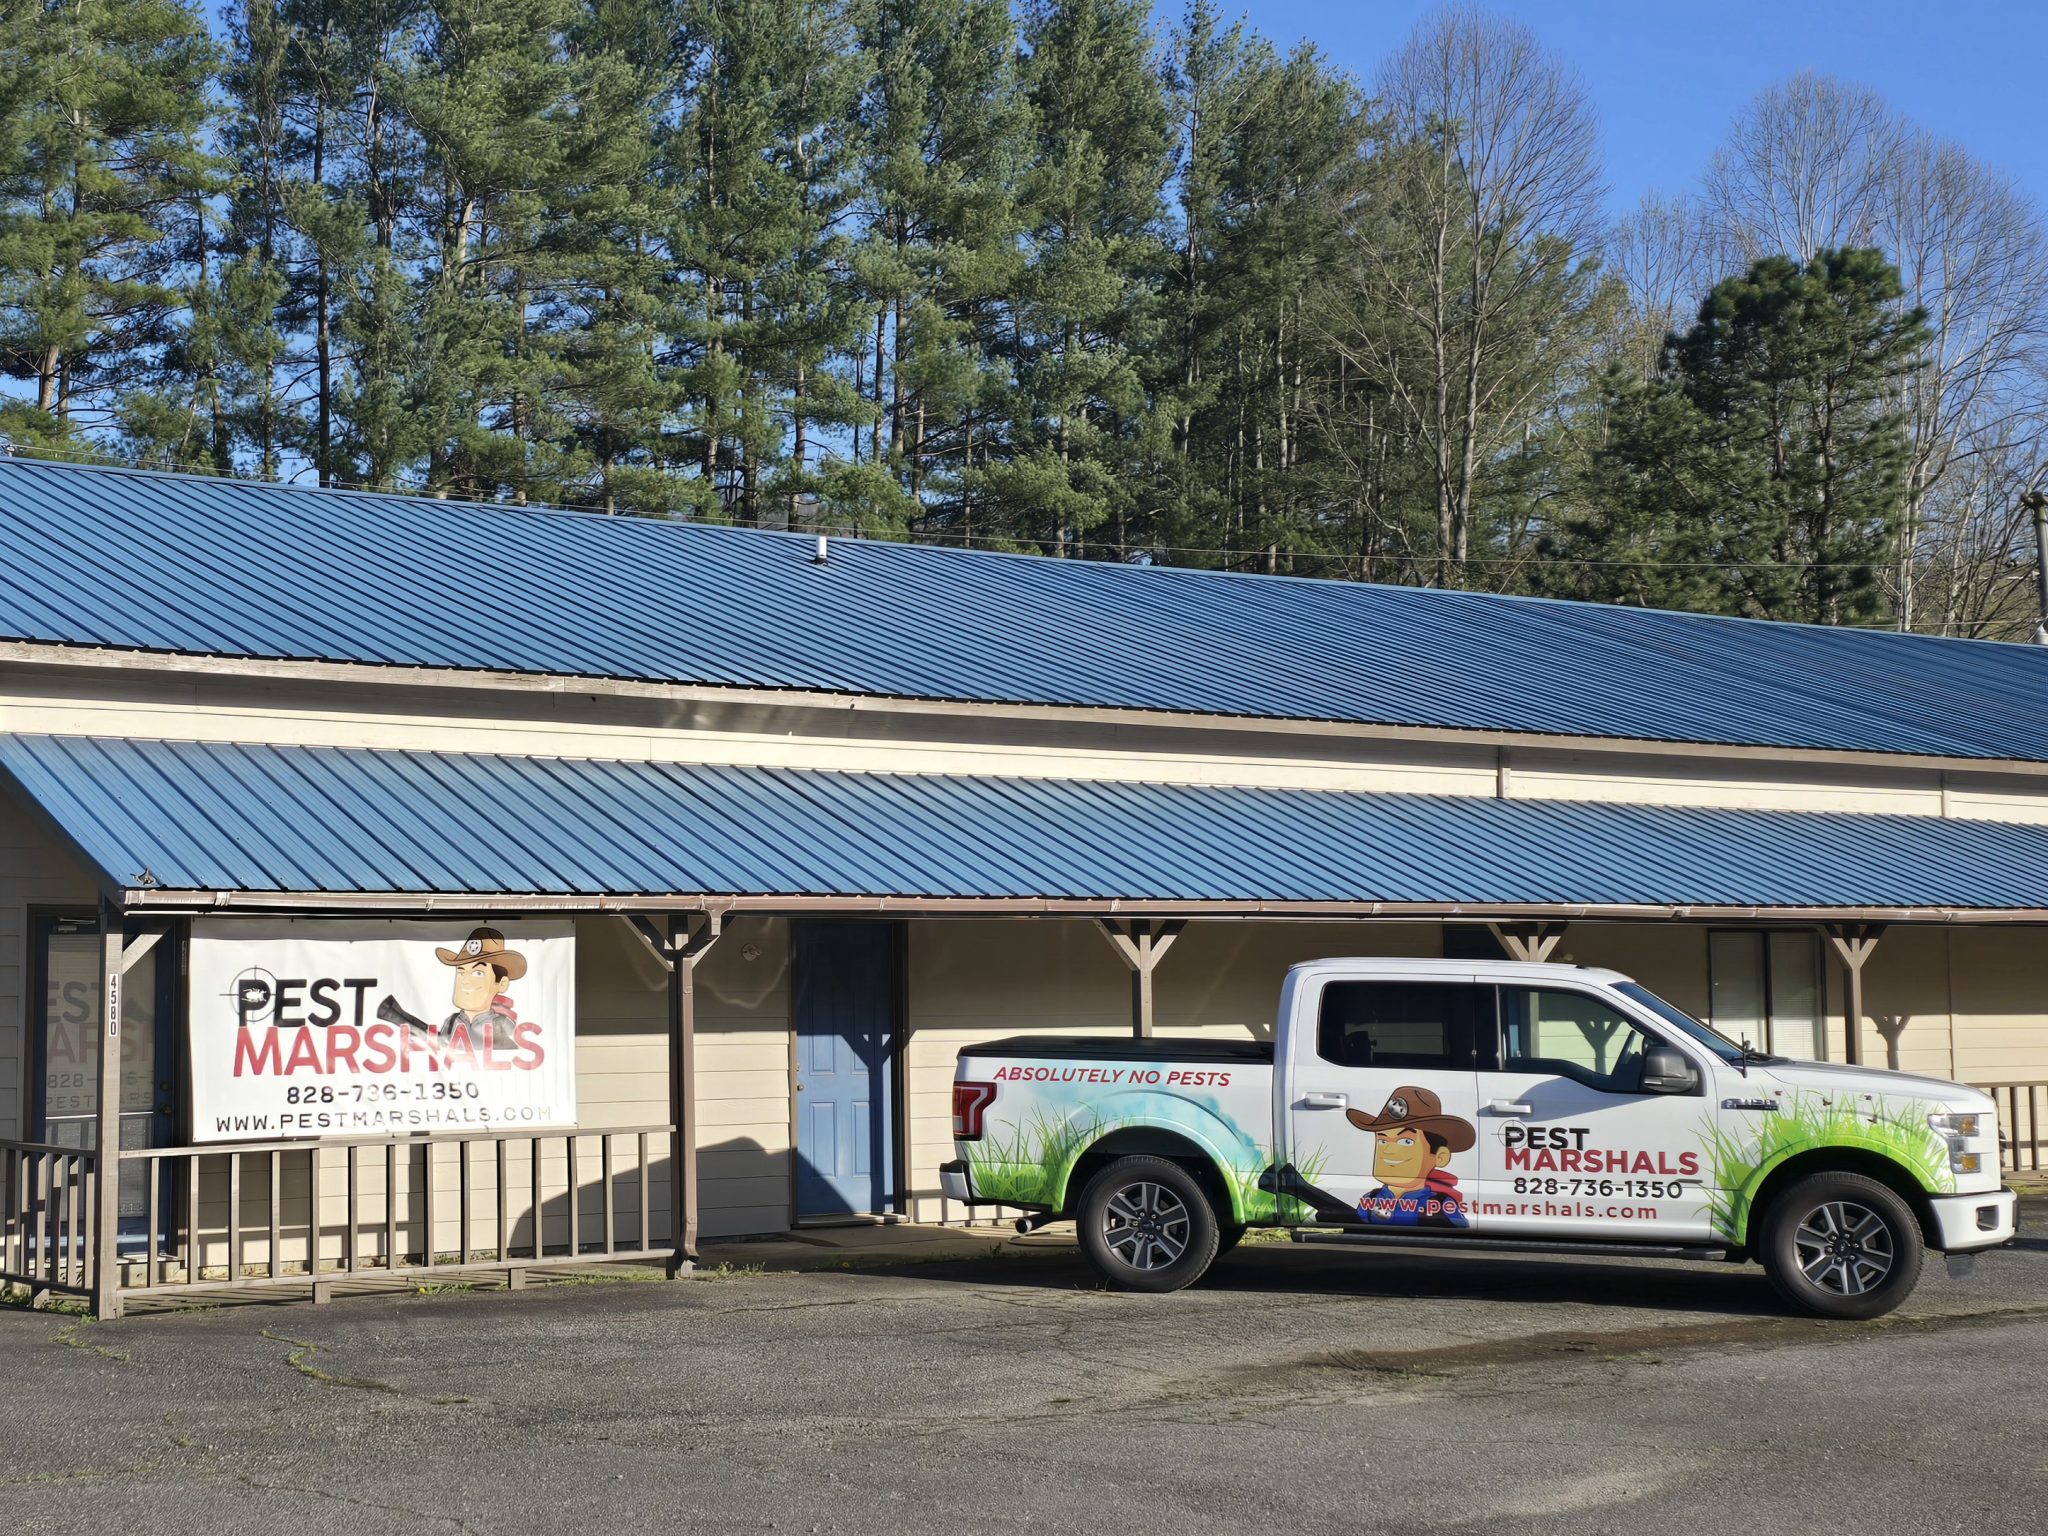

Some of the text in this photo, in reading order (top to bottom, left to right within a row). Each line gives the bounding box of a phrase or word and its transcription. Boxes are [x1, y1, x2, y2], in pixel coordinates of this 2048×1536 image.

[238, 977, 378, 1028] PEST
[233, 1022, 545, 1078] MARSHALS
[993, 1066, 1232, 1087] ABSOLUTELY NO PESTS
[286, 1081, 479, 1105] 828-736-1350
[216, 1106, 552, 1133] WWW.PESTMARSHALS.COM
[1505, 1126, 1590, 1150] PEST
[1505, 1147, 1700, 1176] MARSHALS
[1513, 1177, 1684, 1199] 828-736-1350
[1359, 1197, 1658, 1220] www.pestmarshals.com
